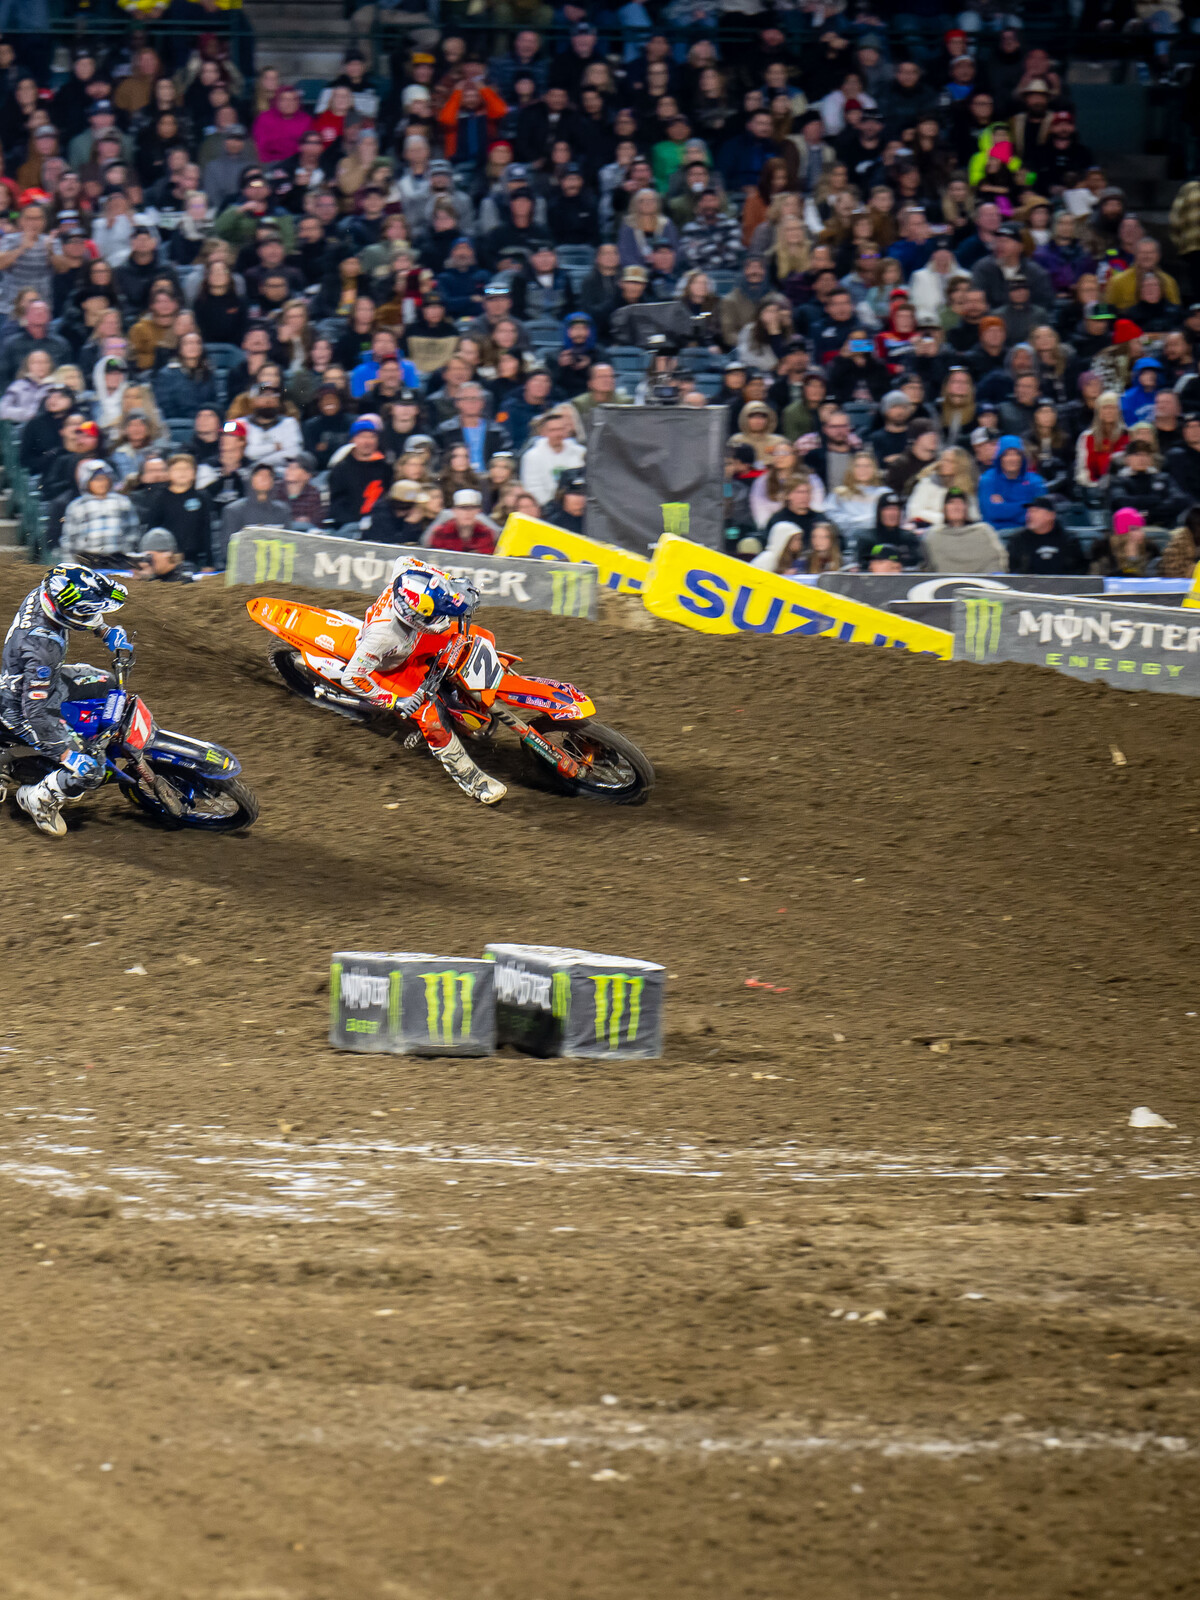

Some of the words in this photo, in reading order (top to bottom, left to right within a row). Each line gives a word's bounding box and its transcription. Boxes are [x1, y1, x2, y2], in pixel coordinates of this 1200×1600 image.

[313, 551, 531, 602] MOTER
[678, 569, 946, 660] SUZ
[473, 643, 501, 690] 2
[1045, 653, 1185, 677] ENERGY
[134, 708, 149, 742] 1
